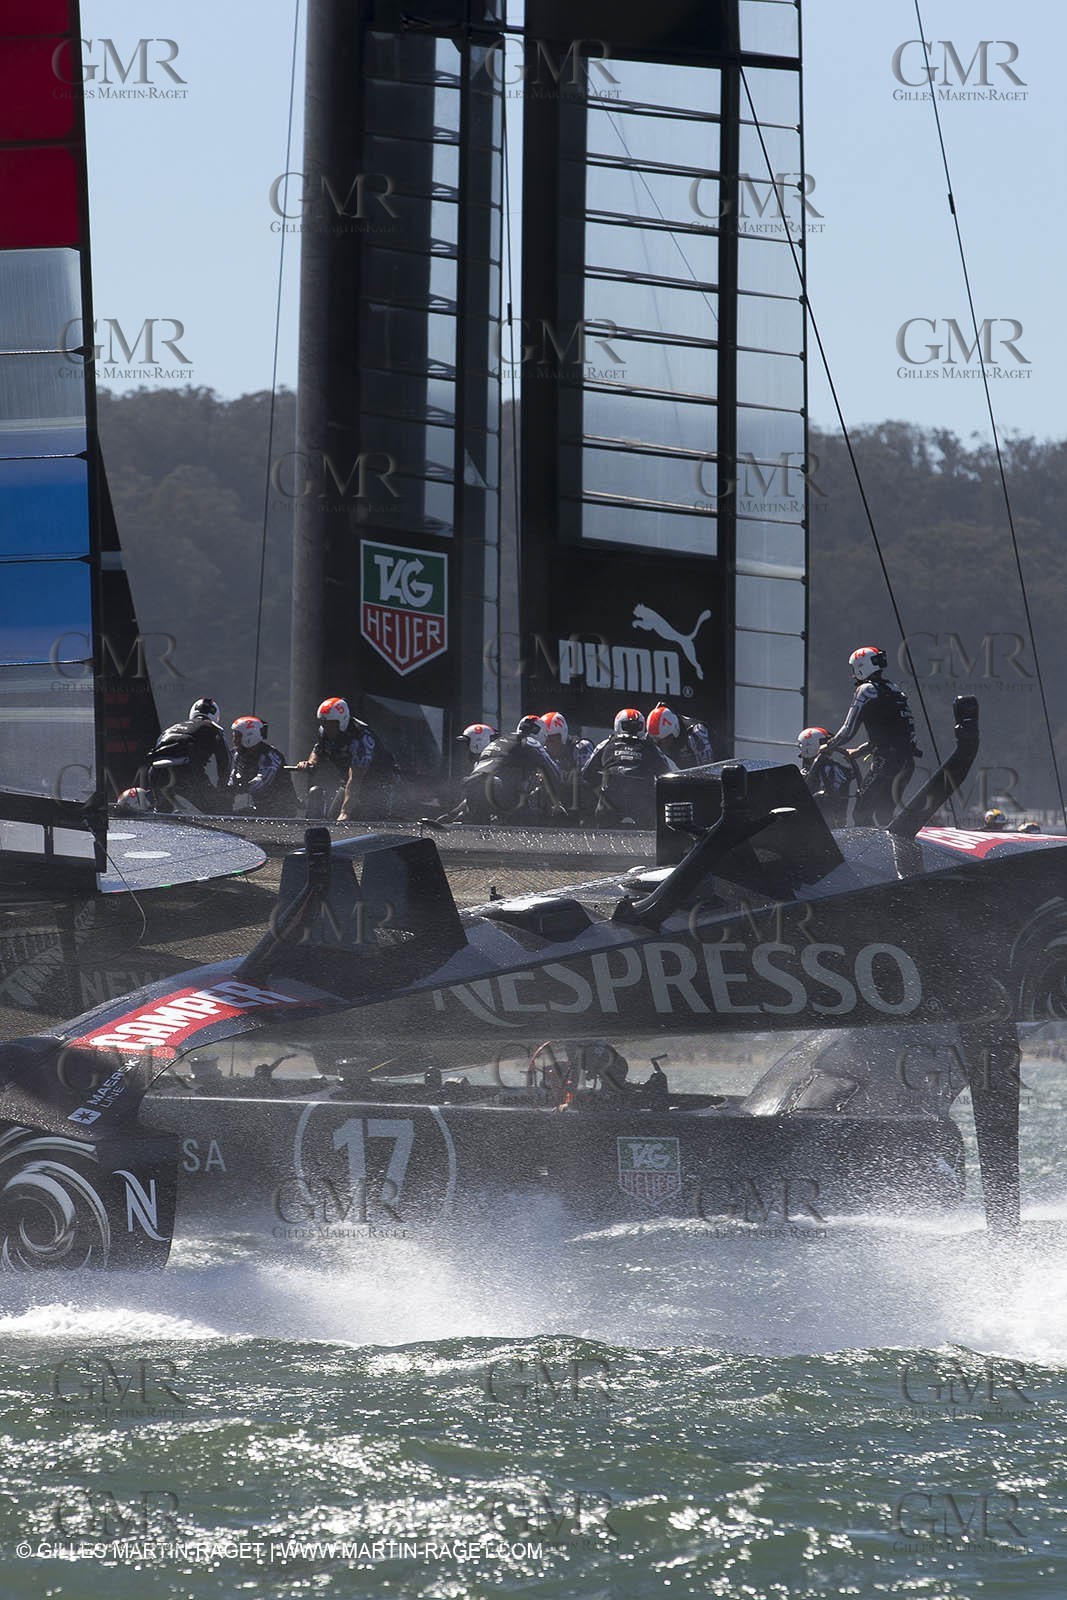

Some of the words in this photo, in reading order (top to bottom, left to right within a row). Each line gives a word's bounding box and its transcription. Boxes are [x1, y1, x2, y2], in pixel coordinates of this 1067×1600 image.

[374, 554, 433, 607] TAG
[367, 608, 441, 665] HEUER
[558, 640, 681, 696] PUMA
[245, 719, 255, 729] 2
[334, 703, 345, 715] 5
[662, 717, 672, 727] 7
[473, 724, 483, 735] 9
[90, 981, 299, 1051] CAMPER
[87, 1059, 140, 1105] MAERSK
[99, 1085, 126, 1109] LINE
[183, 1139, 227, 1172] SA
[332, 1118, 414, 1210] 17
